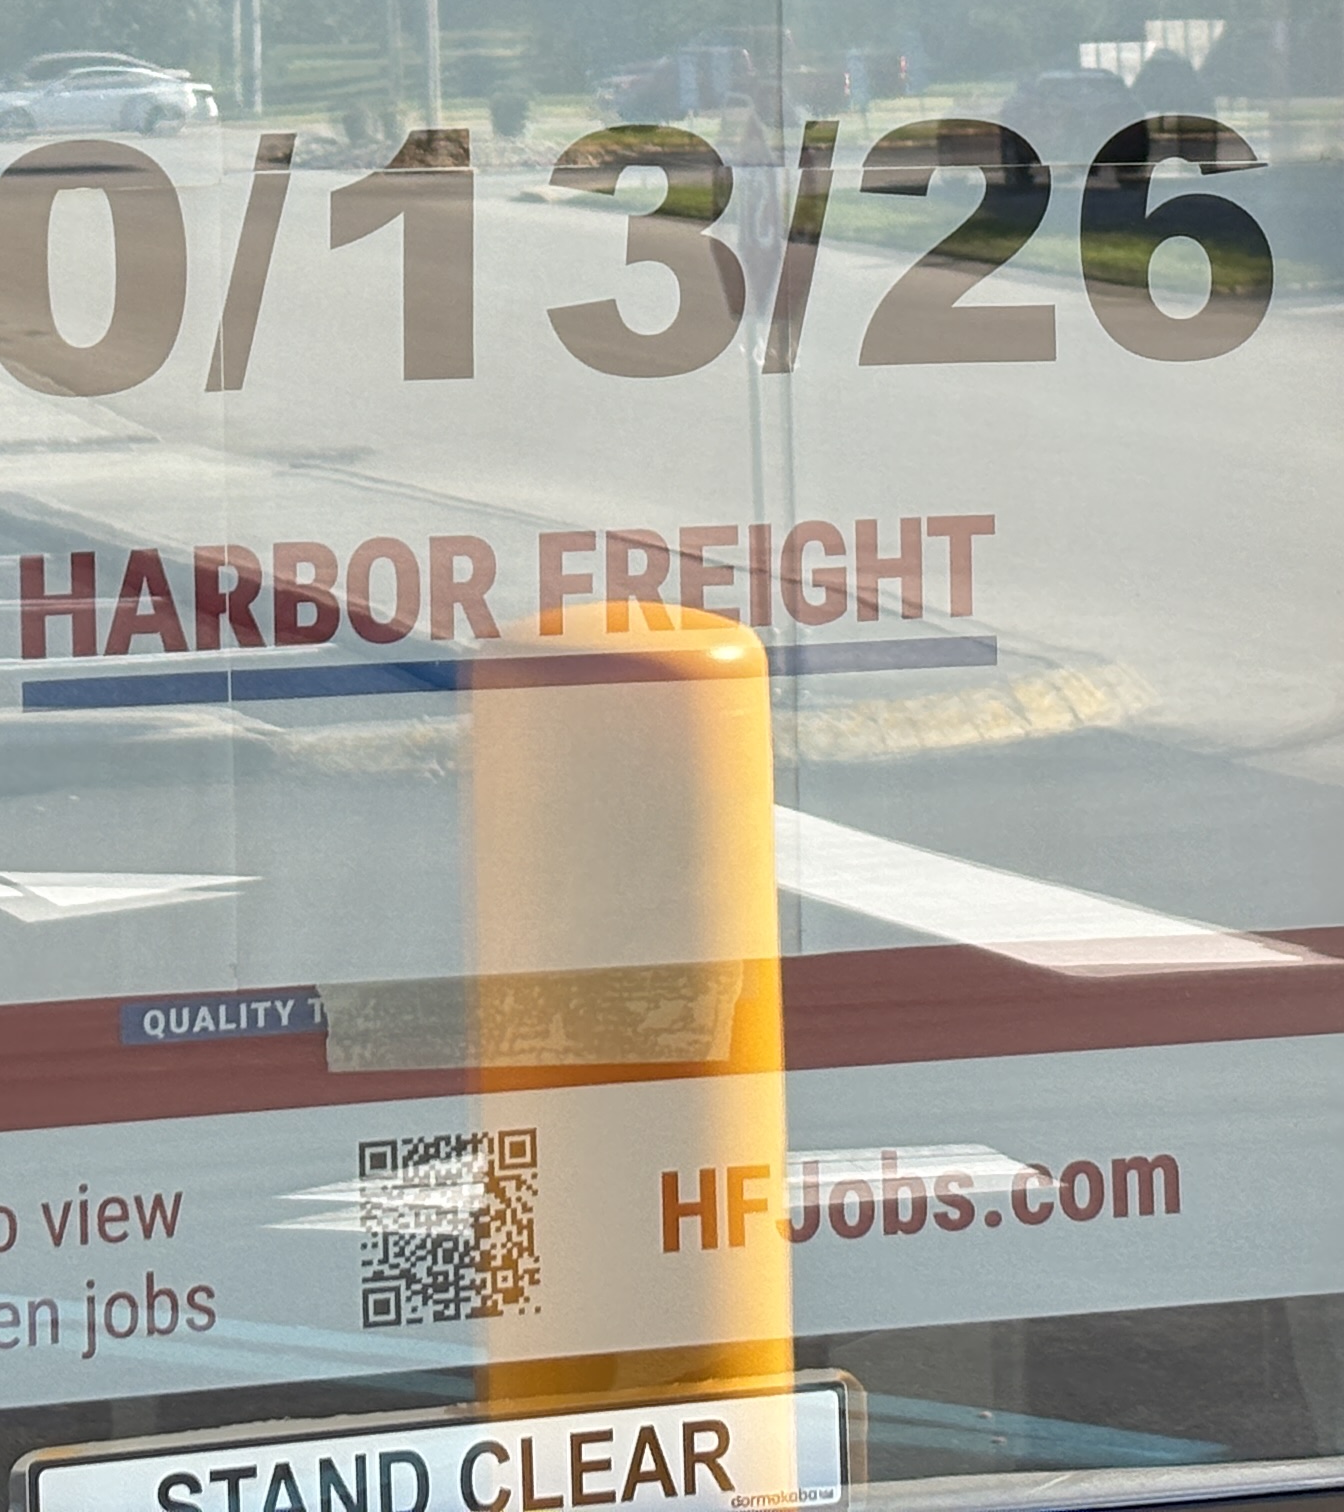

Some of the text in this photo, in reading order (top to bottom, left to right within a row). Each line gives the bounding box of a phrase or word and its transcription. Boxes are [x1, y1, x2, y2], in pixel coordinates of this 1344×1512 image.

[20, 514, 997, 661] HARBOR FREIGHT
[143, 999, 295, 1039] QUALITY
[41, 1183, 184, 1248] view
[660, 1149, 1182, 1254] HFJobs.com
[81, 1271, 218, 1360] jobs
[156, 1418, 735, 1512] STAND CLEAR
[730, 1488, 816, 1508] dormakaba
